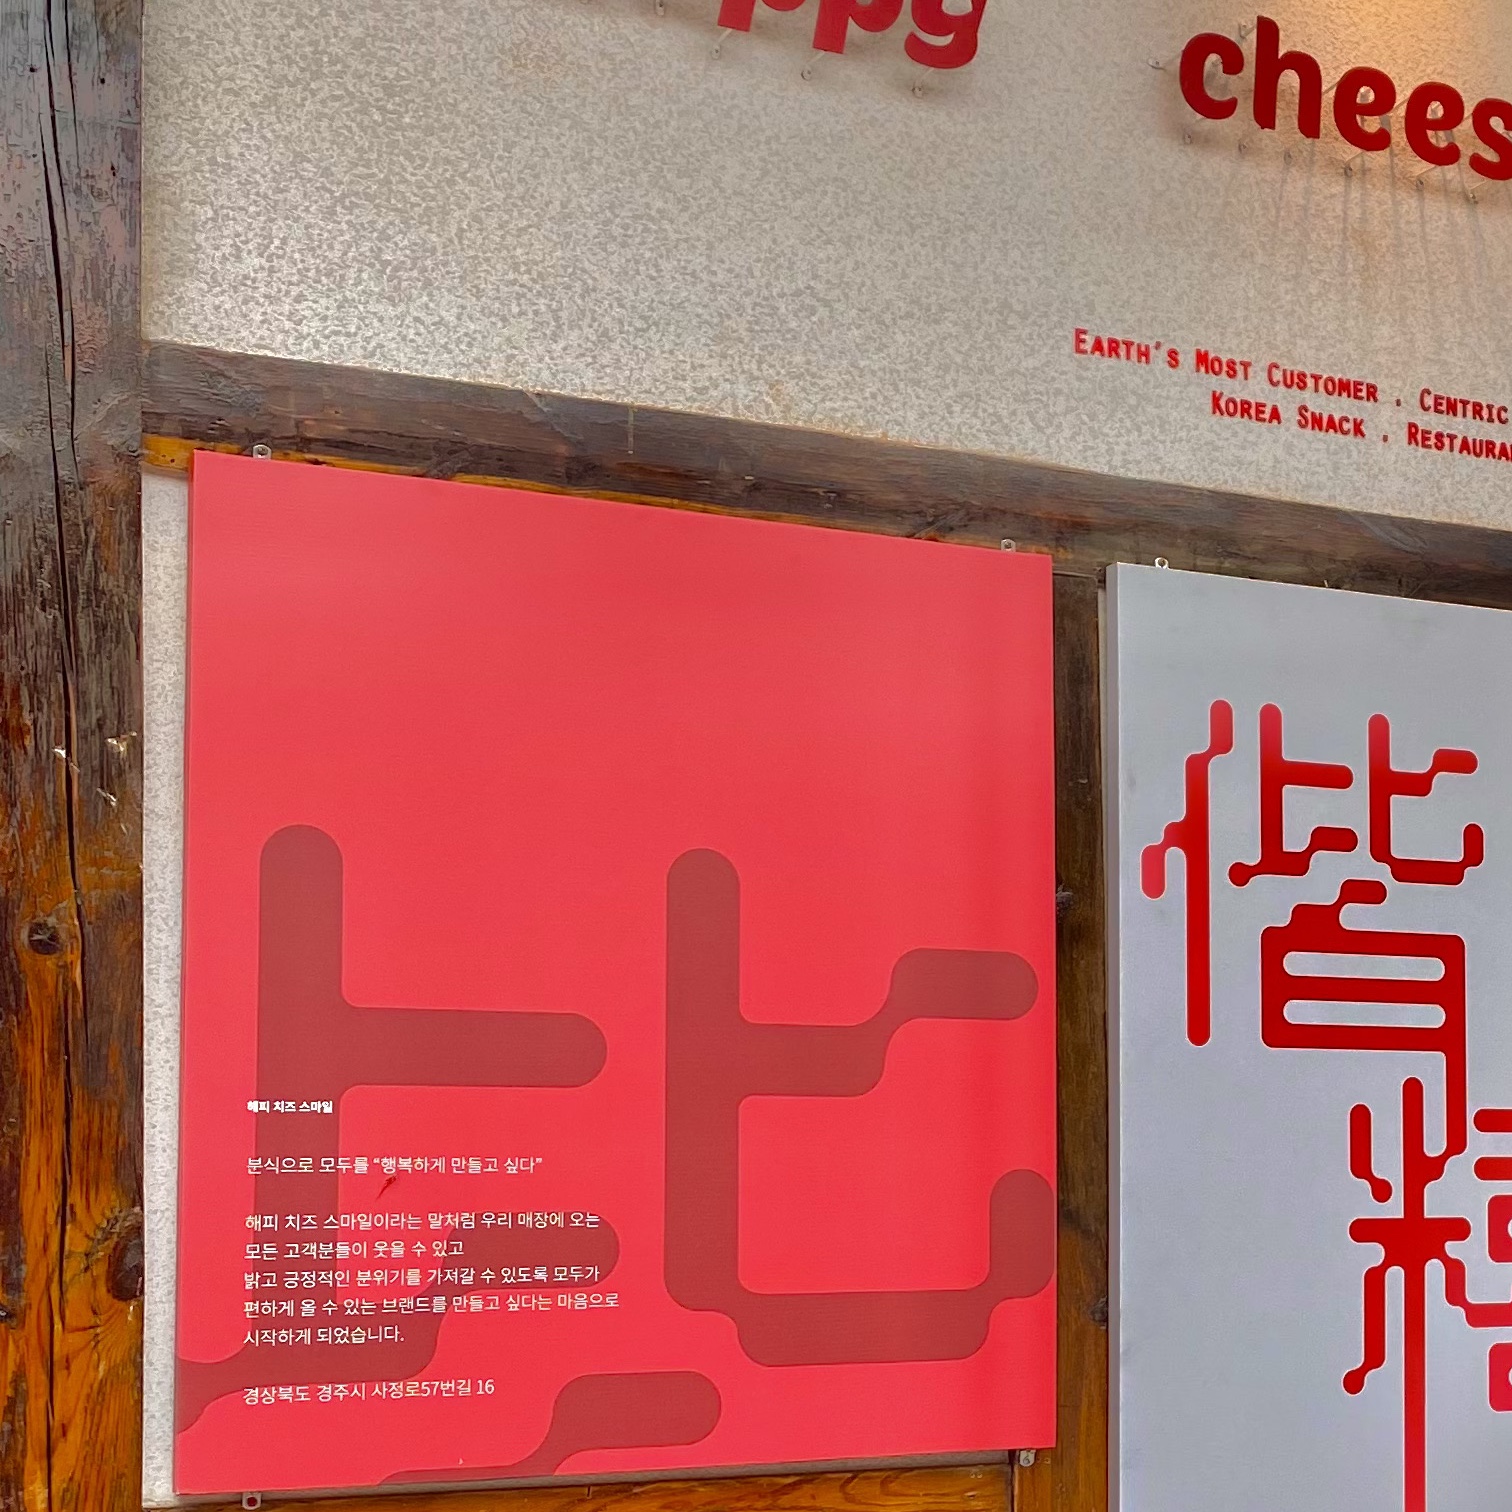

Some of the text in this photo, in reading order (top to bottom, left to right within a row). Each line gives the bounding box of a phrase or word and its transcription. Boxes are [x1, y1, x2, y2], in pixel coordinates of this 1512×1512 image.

[246, 1100, 333, 1114] 해피 치즈 스마일
[246, 1156, 315, 1175] 분식으로
[319, 1156, 369, 1174] 모두를
[450, 1156, 499, 1174] 만들고
[245, 1211, 600, 1232] 해피 치즈 스마일이라는 말처럼 우리 매장에 오는
[244, 1240, 465, 1261] 모든 고객분들이 웃을 수 있고
[243, 1265, 601, 1290] 밝고 긍정적인 분위기를 가져갈 수 있도록 모두가
[243, 1292, 620, 1319] 편하게 올 수 있는 브랜드를 만들고 싶다는 마음으로
[243, 1325, 405, 1347] 시작하게 되었습니다.
[242, 1378, 495, 1406] 경상북도 경주시 사정로57번길 16
